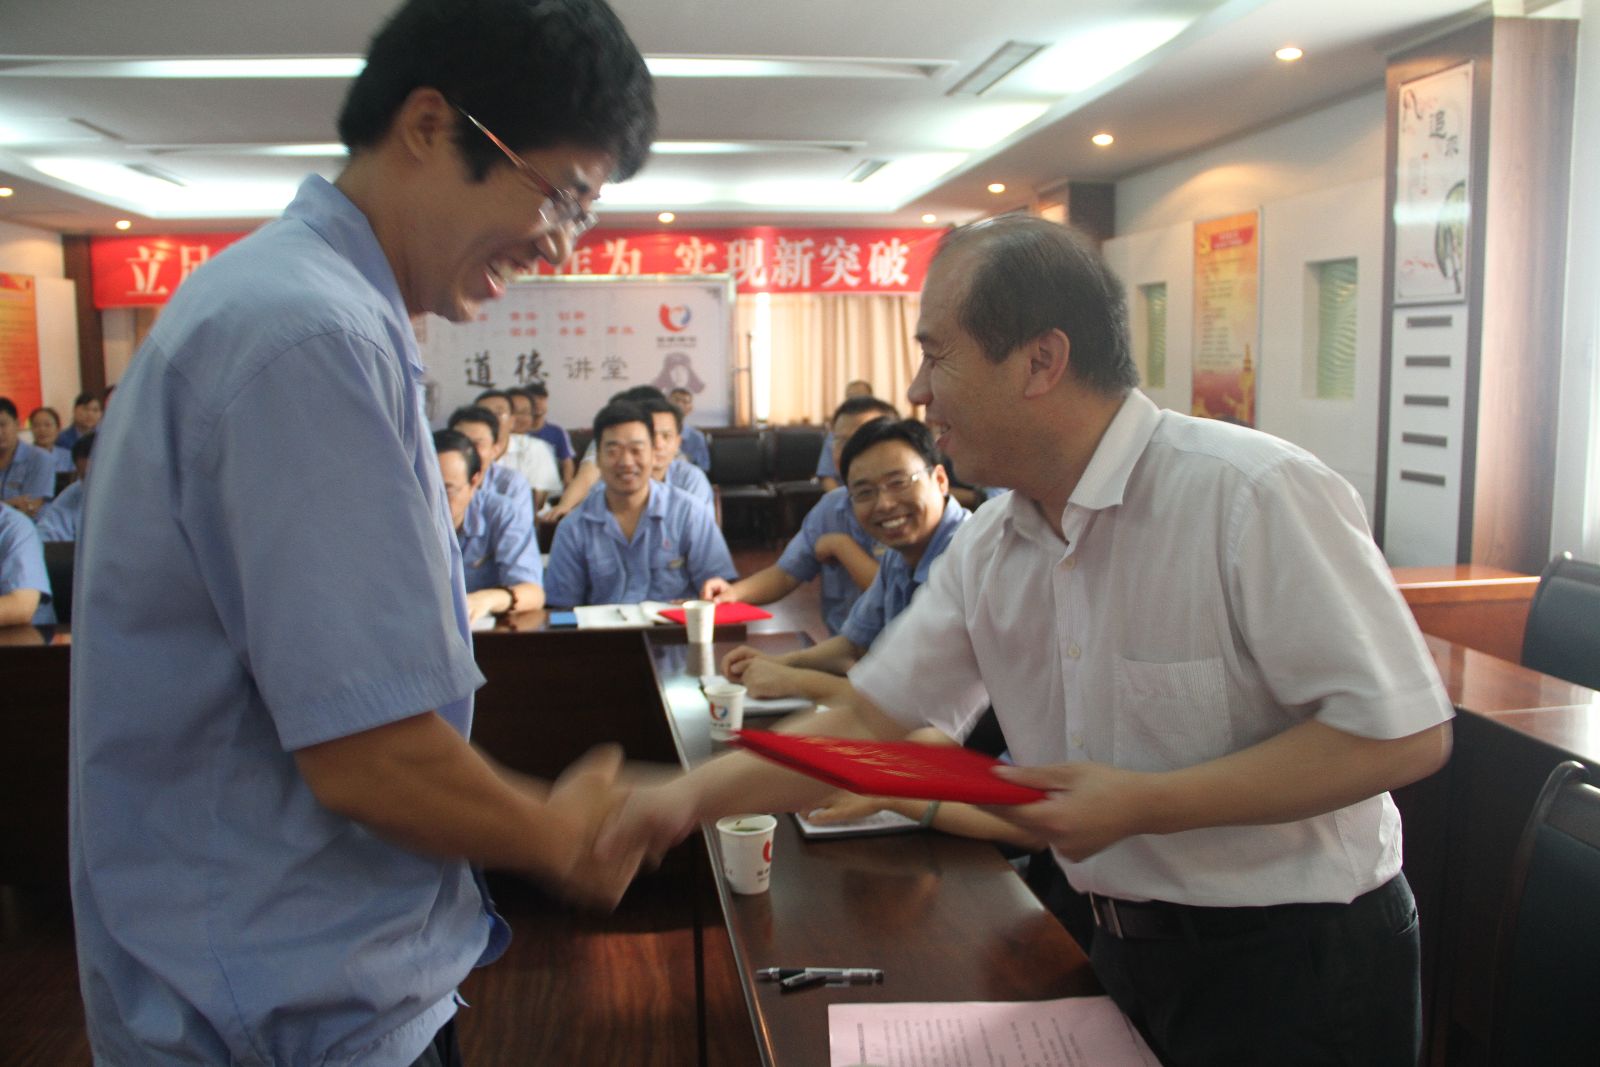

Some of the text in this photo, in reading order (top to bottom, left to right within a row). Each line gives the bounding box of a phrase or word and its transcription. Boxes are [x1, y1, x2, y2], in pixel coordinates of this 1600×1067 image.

[674, 237, 911, 287] 实现新突破
[464, 350, 631, 389] 道德讲堂
